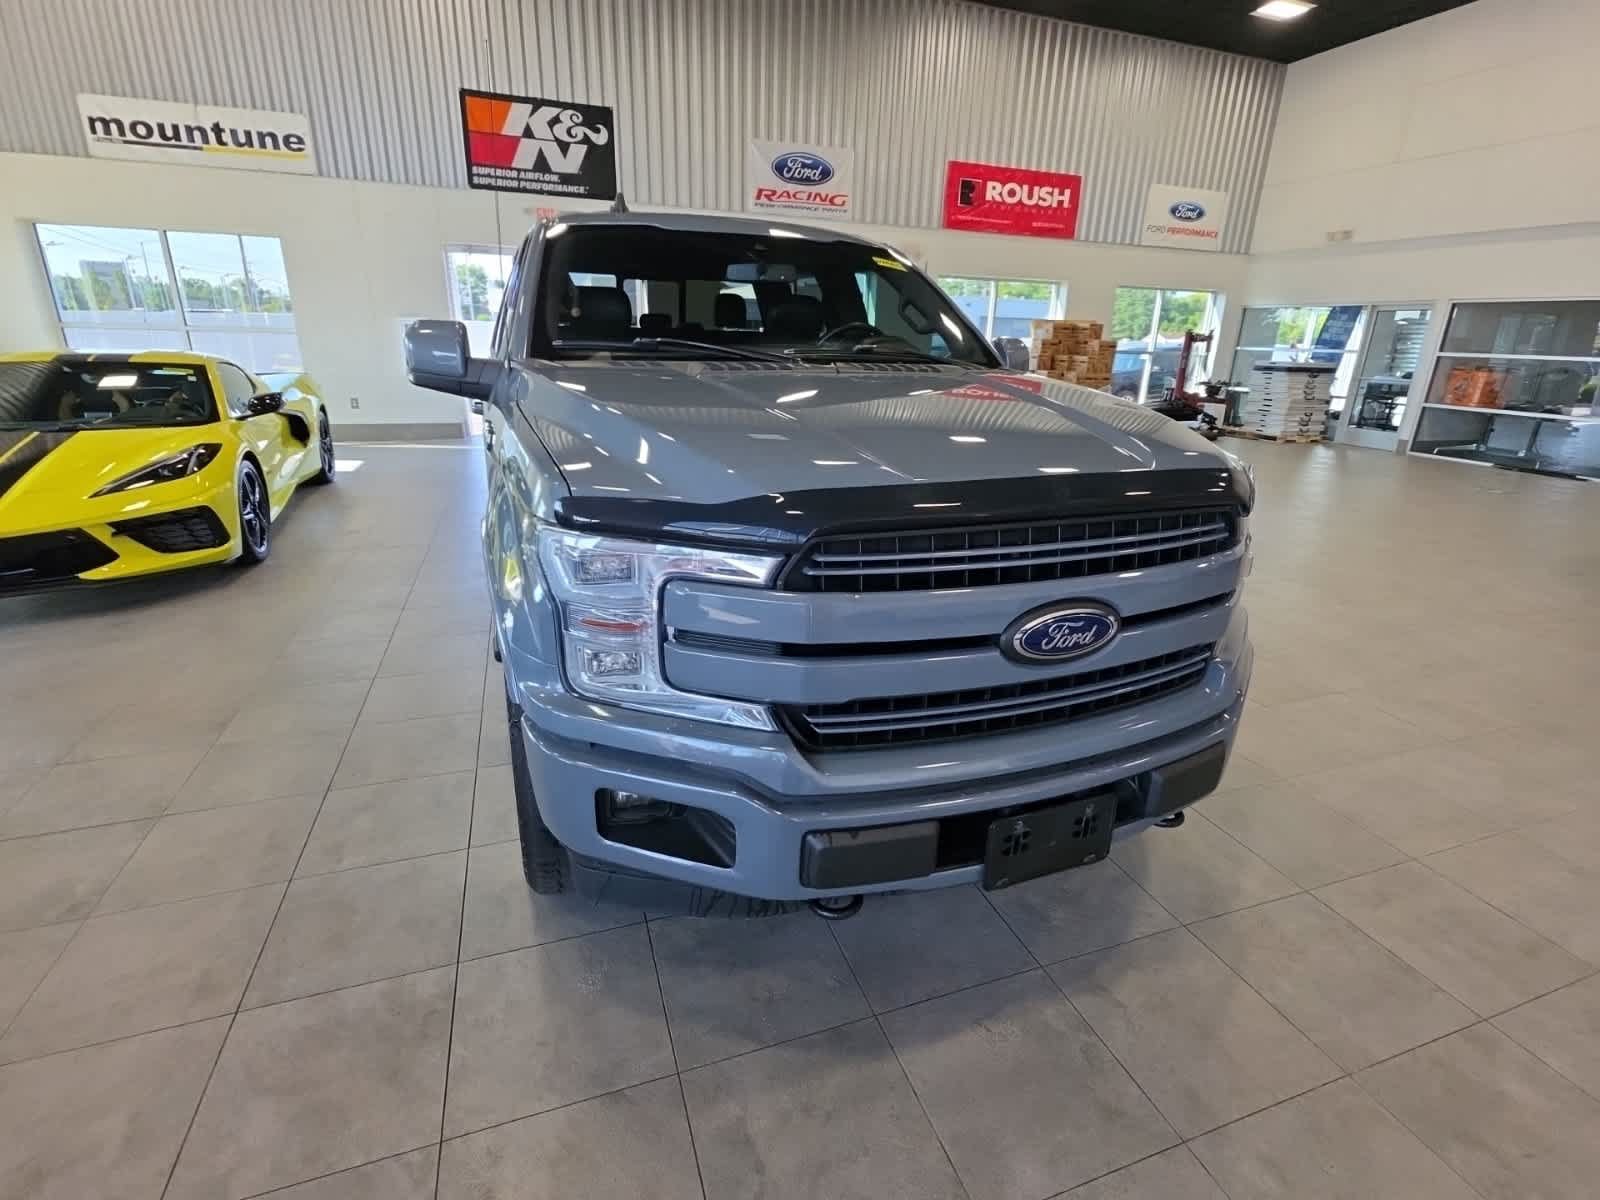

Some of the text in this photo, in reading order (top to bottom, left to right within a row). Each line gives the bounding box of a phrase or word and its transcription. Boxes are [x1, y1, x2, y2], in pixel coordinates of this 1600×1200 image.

[87, 114, 306, 152] mountune
[472, 166, 561, 183] SUPERIOR AIRFLOW.
[783, 157, 823, 181] Ford
[472, 176, 519, 188] SUPERIOR
[755, 187, 848, 207] RACING
[985, 180, 1072, 208] ROUSH
[1175, 203, 1200, 219] Ford
[1041, 620, 1098, 650] Ford
